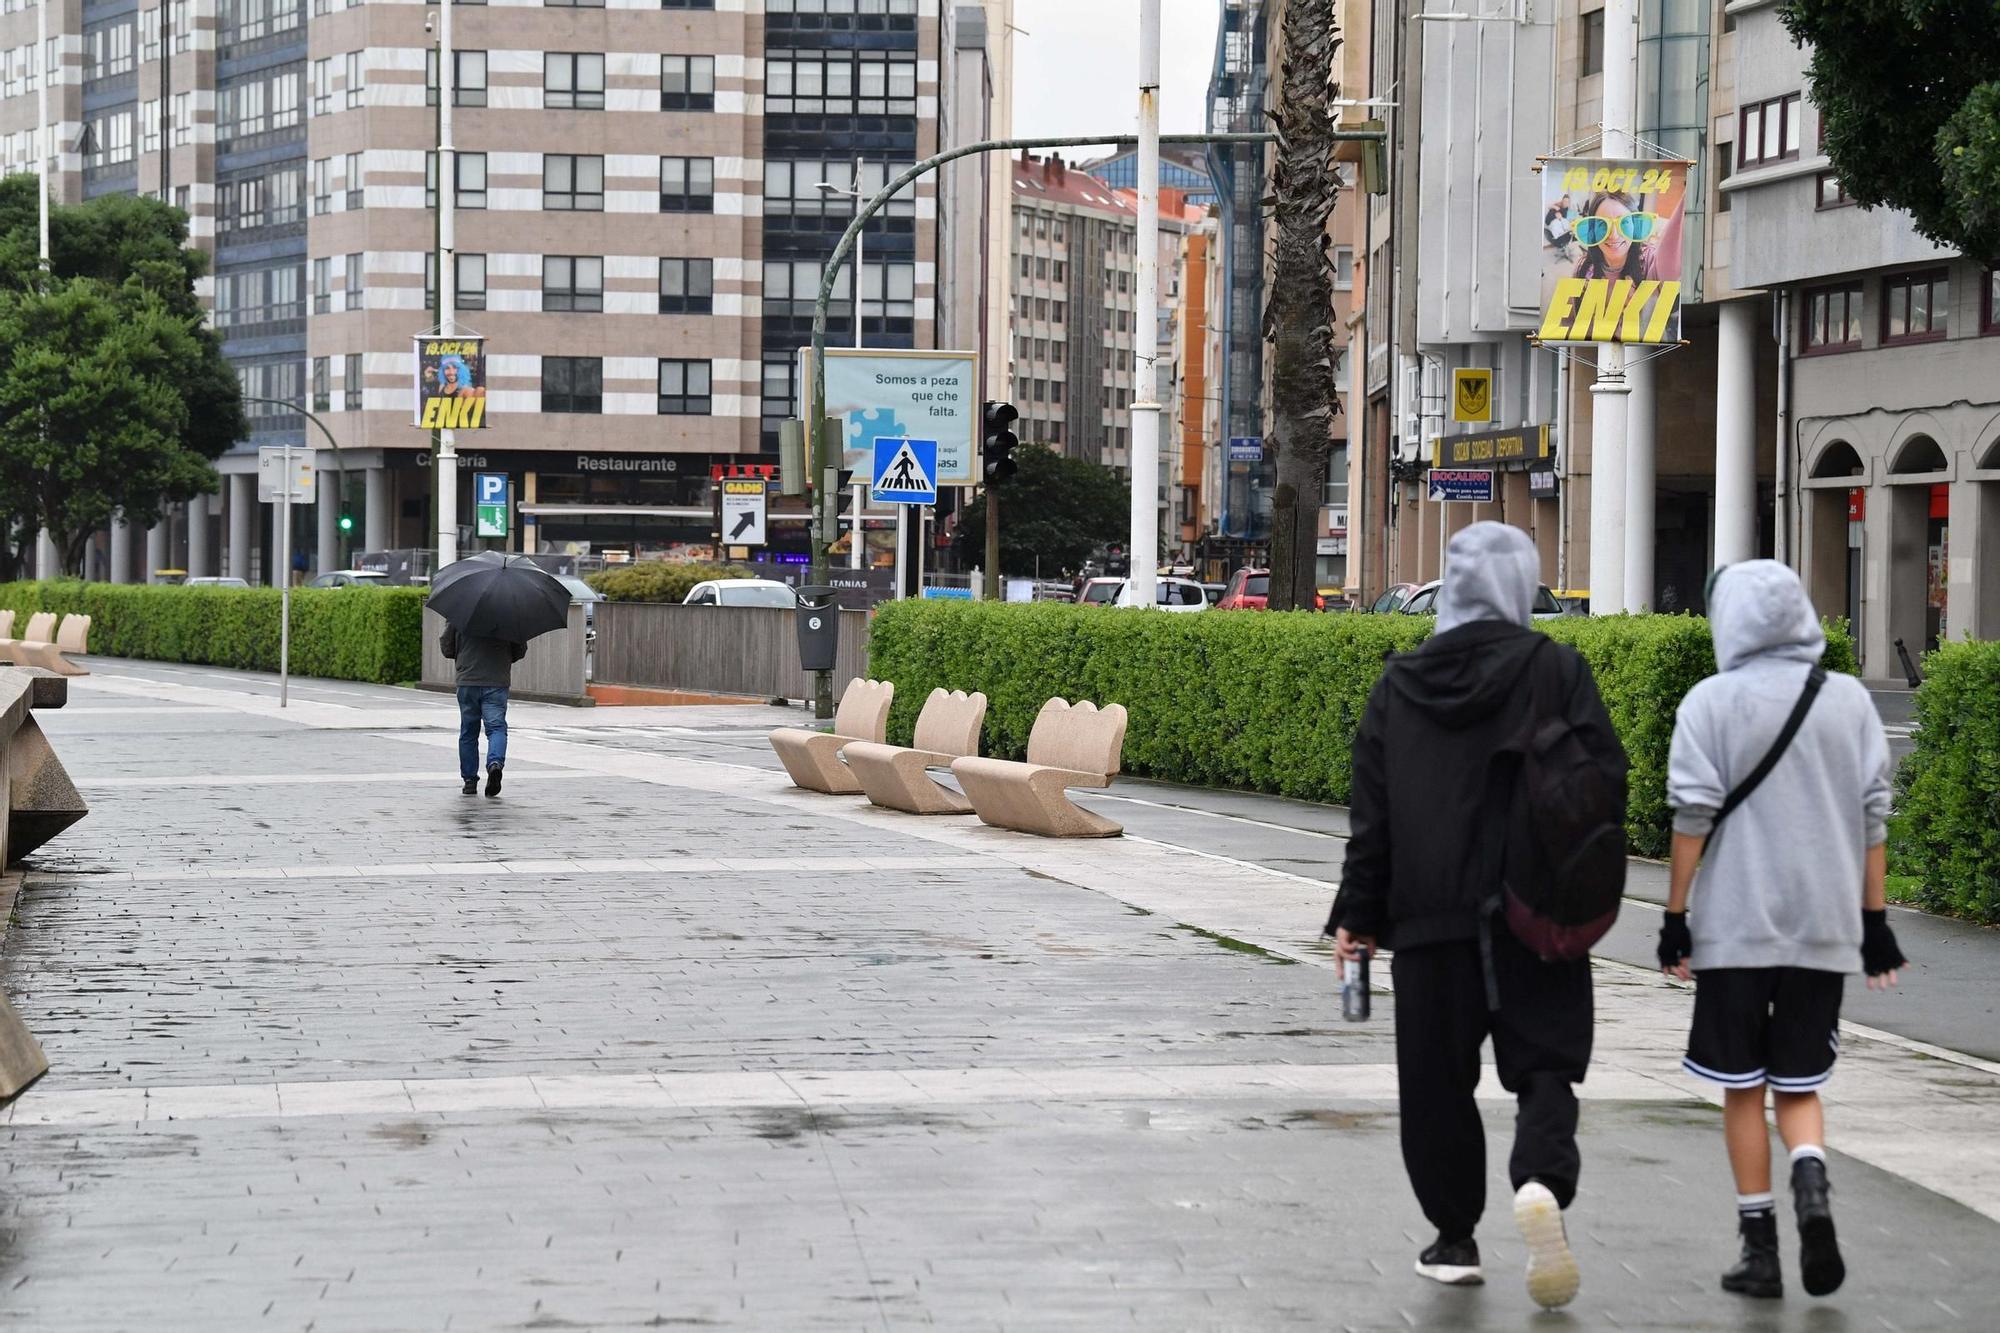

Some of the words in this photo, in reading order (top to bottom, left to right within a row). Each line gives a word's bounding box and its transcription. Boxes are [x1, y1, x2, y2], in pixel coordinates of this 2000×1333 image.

[1561, 167, 1672, 194] 19.OCT.24
[1538, 278, 1682, 343] ENKI
[875, 374, 917, 385] Somos
[920, 377, 927, 385] a
[931, 377, 959, 387] peza
[911, 392, 933, 402] que
[937, 391, 958, 401] che
[421, 397, 485, 428] ENKI
[929, 406, 958, 417] falta.
[415, 453, 488, 468] Caería
[577, 456, 677, 471] Restaurante
[1431, 472, 1490, 481] BOCALINO
[483, 476, 503, 500] P
[725, 483, 763, 494] GADIS
[830, 579, 868, 589] ITANIAS
